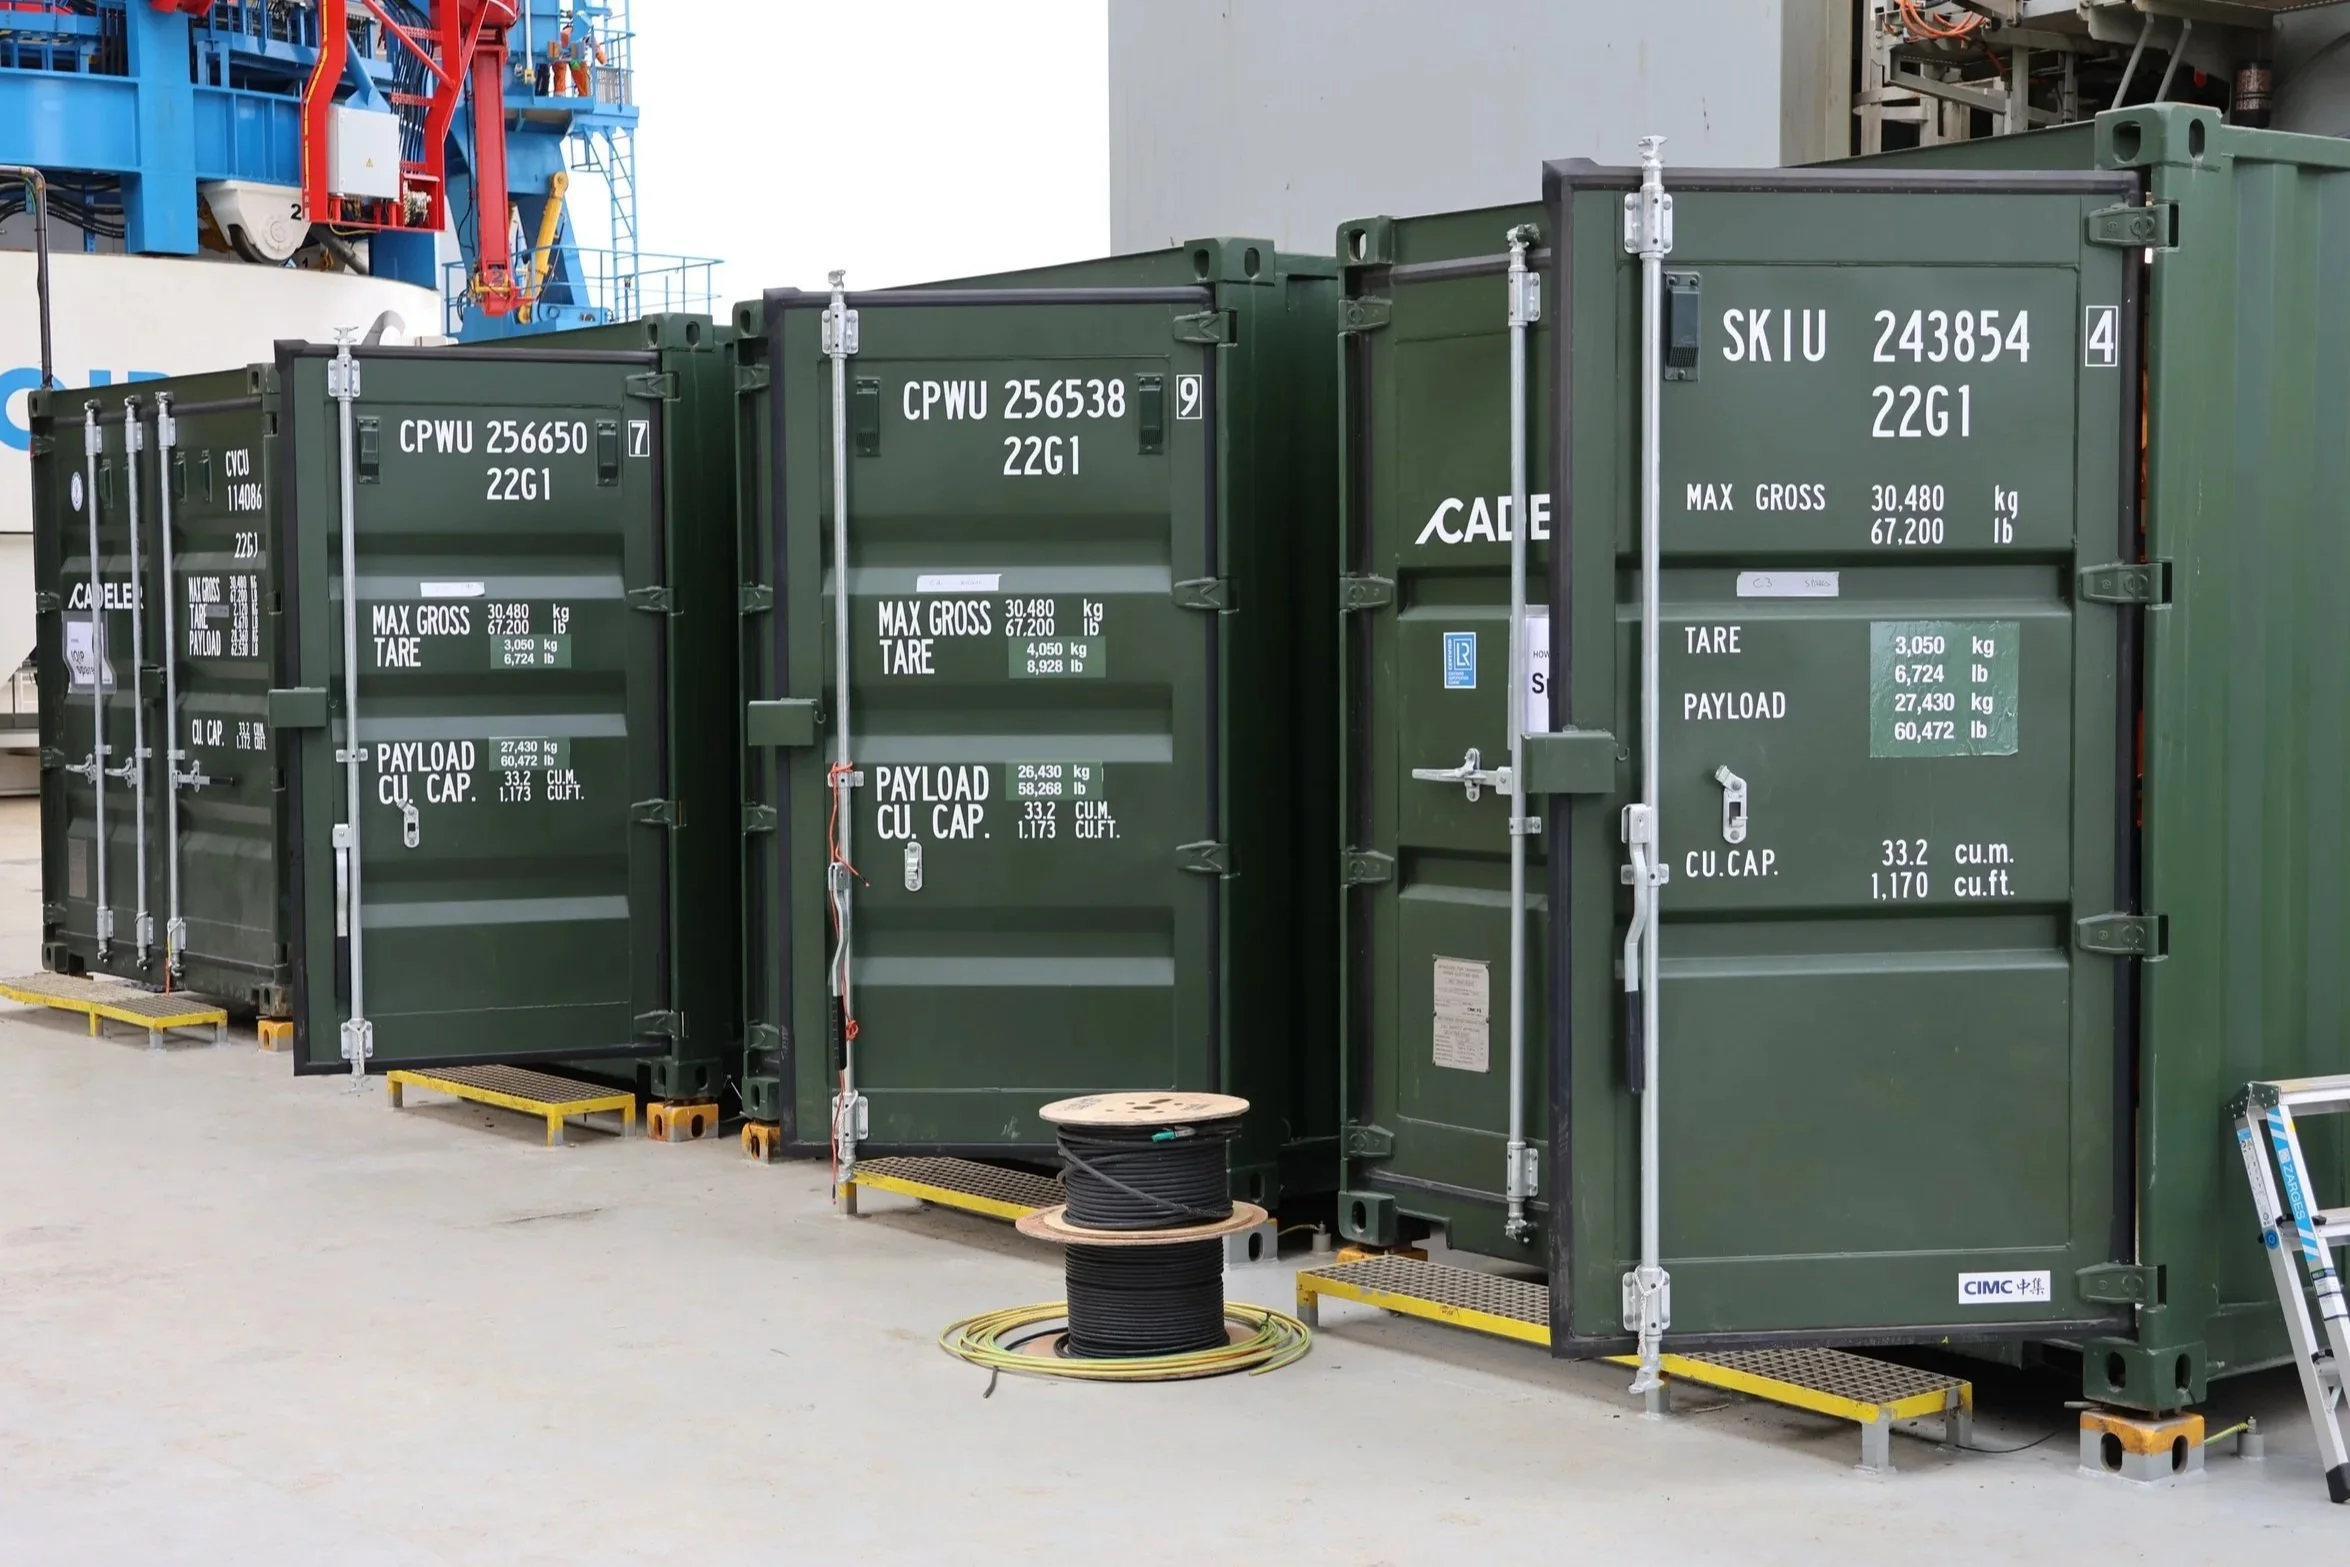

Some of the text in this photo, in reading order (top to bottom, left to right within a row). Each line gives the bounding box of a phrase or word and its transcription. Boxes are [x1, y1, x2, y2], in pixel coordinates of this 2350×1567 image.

[291, 204, 302, 220] 2
[1722, 309, 2114, 363] SKIU 243854 4
[903, 379, 1199, 421] CPWU 256538 9
[1872, 385, 1970, 438] 22G1
[400, 420, 646, 454] CPWU 256650 7
[225, 448, 249, 477] CVCU
[1003, 436, 1079, 476] 22G1
[228, 483, 262, 511] 114086
[486, 468, 550, 500] 22G1
[1686, 484, 2018, 522] MAX GROSS 30,480 kg
[234, 531, 258, 558] 22G1
[1870, 518, 2015, 545] 67,200 lb
[188, 576, 220, 603] MAX GROSS
[189, 603, 208, 629] TARE
[372, 606, 470, 635] MAX GROSS
[552, 604, 570, 623] kg
[878, 601, 992, 637] MAX GROSS
[1083, 599, 1103, 621] kg
[553, 621, 568, 635] lb
[1083, 620, 1101, 636] lb
[1684, 627, 1741, 654] TARE
[189, 630, 221, 656] PAYLOAD
[374, 638, 422, 667] TARE
[504, 639, 558, 653] 3,050 kg
[1026, 643, 1087, 658] 4,050 kg
[1895, 636, 1995, 658] 3,050 kg
[504, 653, 554, 666] 6,724 lb
[879, 639, 935, 675] TARE
[1027, 660, 1083, 675] 8,928 lb
[1532, 672, 1549, 699] S
[1894, 664, 1988, 687] 6,724 lb
[1684, 692, 1786, 720] PAYLOAD
[1894, 693, 1994, 715] 27,430 kg
[192, 719, 224, 746] CU. CAP.
[1894, 721, 1987, 744] 60,472 lb
[377, 742, 475, 773] PAYLOAD
[500, 741, 558, 754] 27,430 kg
[500, 755, 554, 768] 60,472 lb
[1018, 765, 1090, 781] 26,430 kg
[378, 774, 476, 805] CU. CAP.
[504, 770, 577, 786] 33.2 CU.M.
[876, 766, 989, 802] PAYLOAD
[1018, 782, 1086, 797] 58,268 lb
[547, 785, 585, 801] CU.FT.
[877, 804, 990, 840] CU. CAP.
[1024, 802, 1112, 820] 33.2 CU.M.
[1075, 820, 1121, 839] CU.FT.
[1685, 839, 2014, 878] CU.CAP. 33.2 cu.m.
[1871, 871, 2015, 901] 1,170 cu.ft.
[2282, 1165, 2306, 1220] ZARGES
[1963, 1277, 2045, 1296] CIMC 中集
